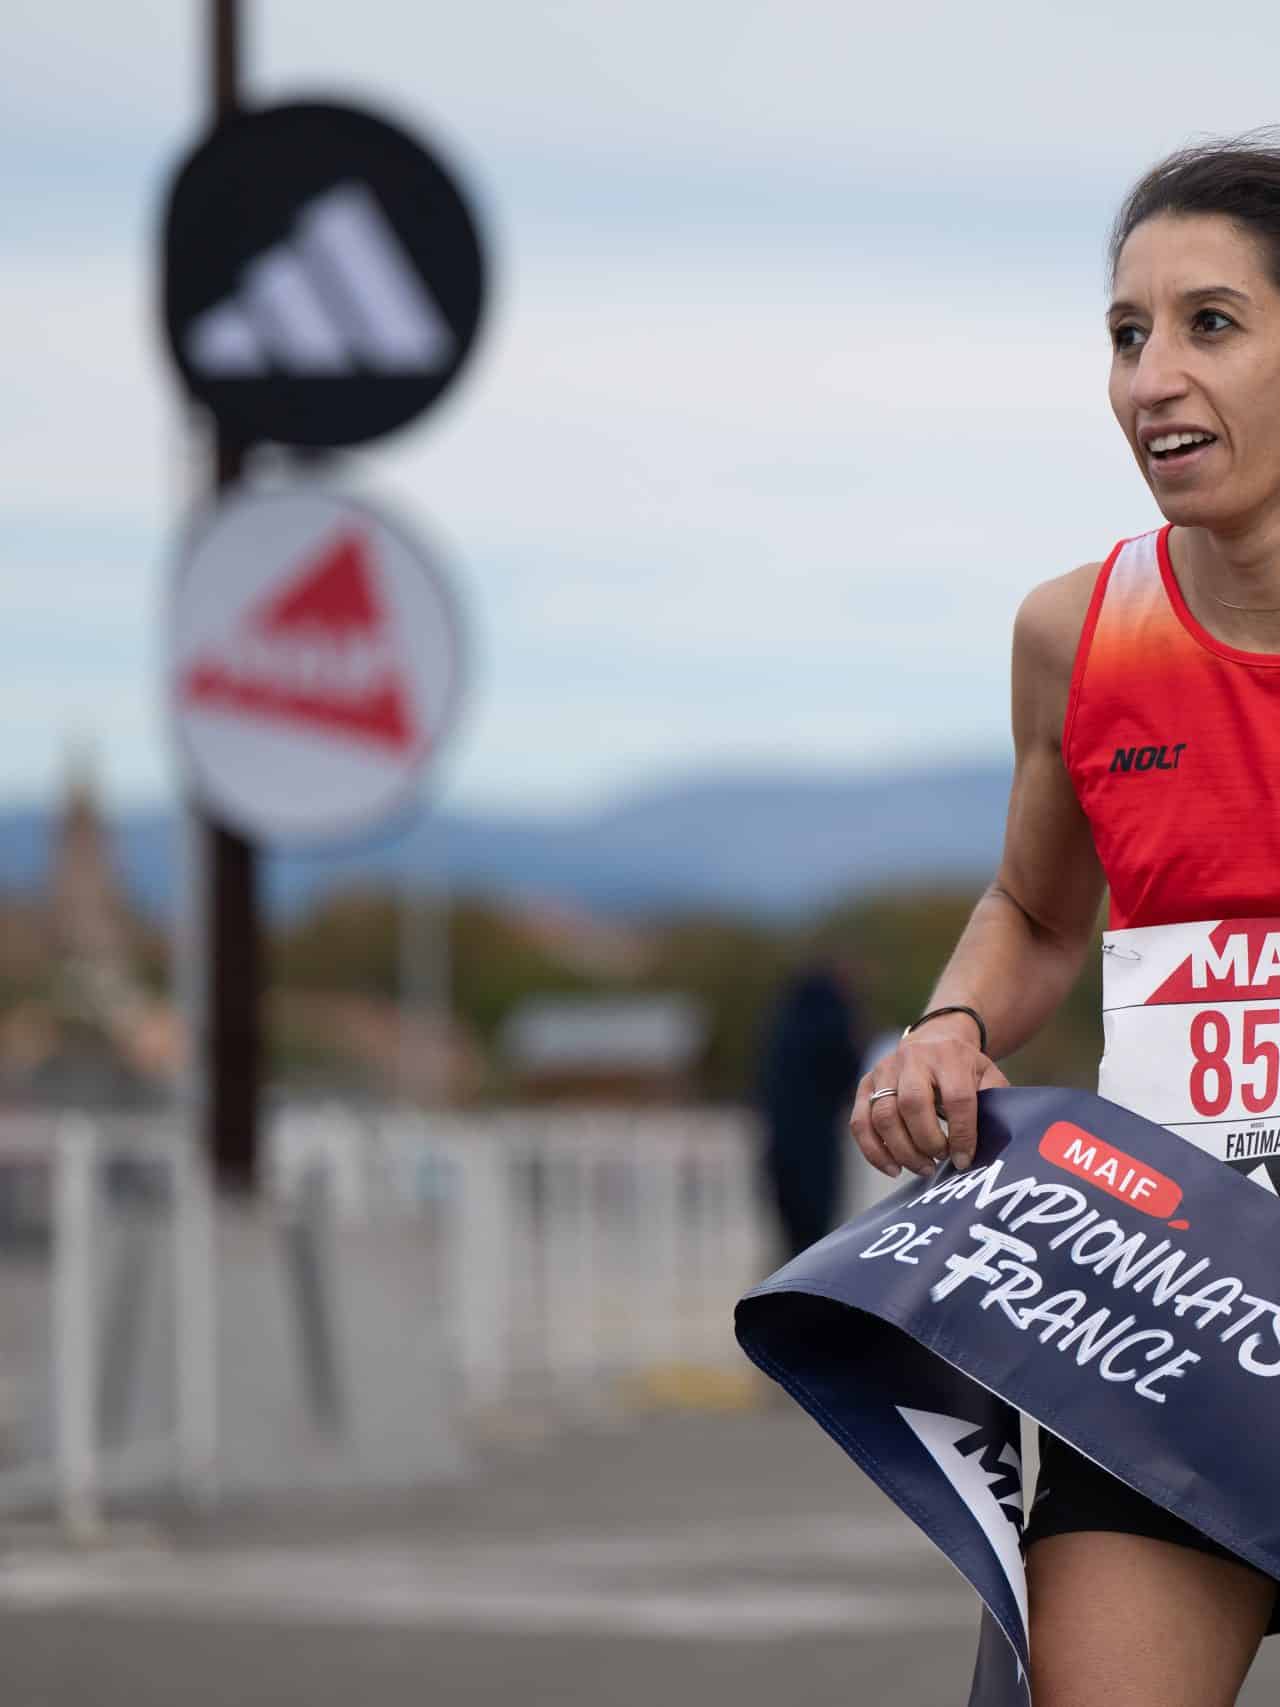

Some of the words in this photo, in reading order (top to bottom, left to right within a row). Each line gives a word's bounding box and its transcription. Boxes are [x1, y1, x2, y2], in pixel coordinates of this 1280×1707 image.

[1109, 743, 1187, 772] NOLT
[1063, 1138, 1158, 1202] MAIF
[860, 1221, 943, 1265] DE
[932, 1223, 1201, 1403] FRANCE
